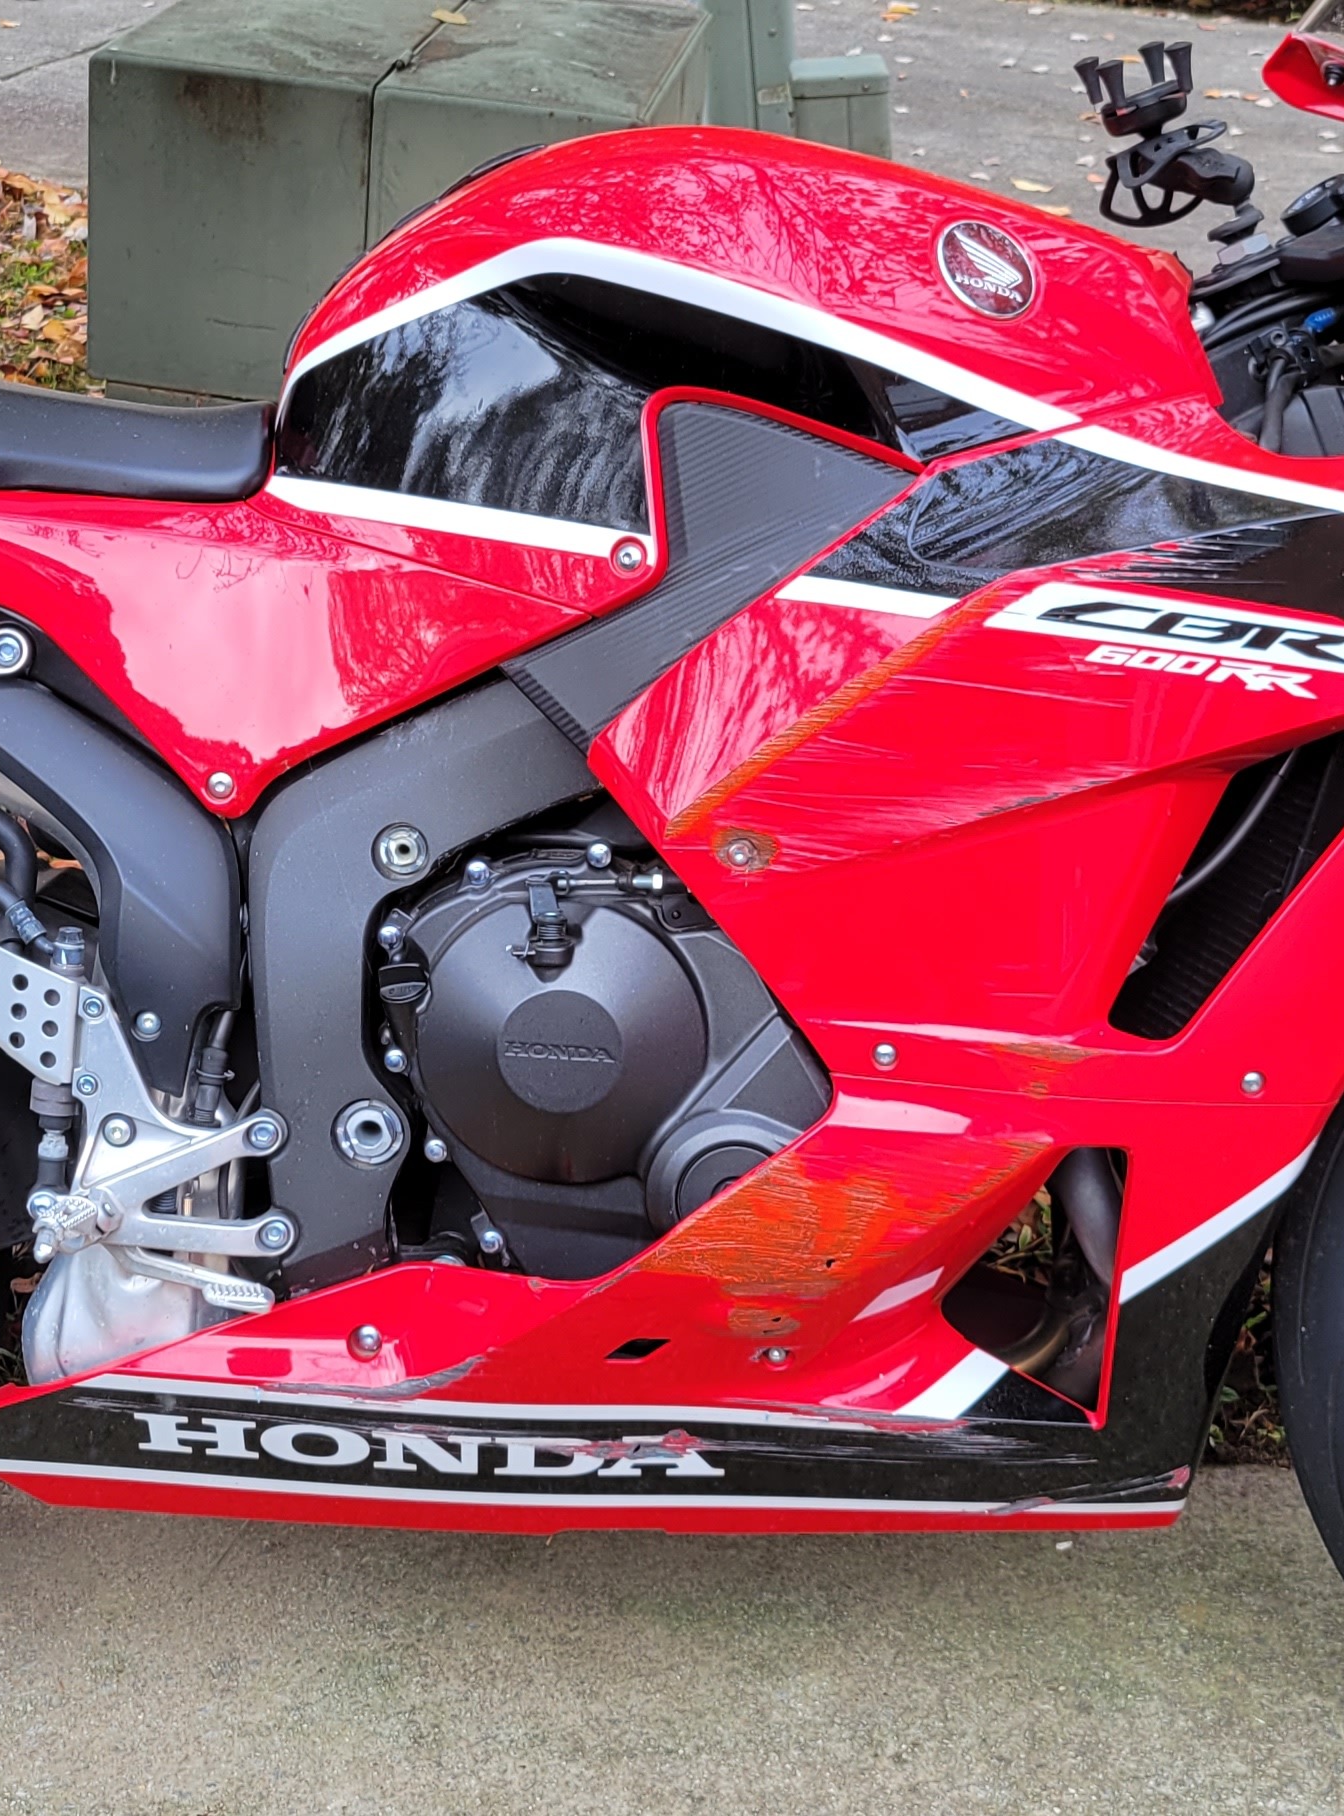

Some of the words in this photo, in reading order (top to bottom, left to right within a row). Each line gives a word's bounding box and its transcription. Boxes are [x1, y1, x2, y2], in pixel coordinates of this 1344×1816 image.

[955, 273, 1023, 303] HONDA
[1085, 646, 1317, 699] 600RR
[504, 1041, 616, 1063] HONDA
[134, 1412, 725, 1478] HONDA
